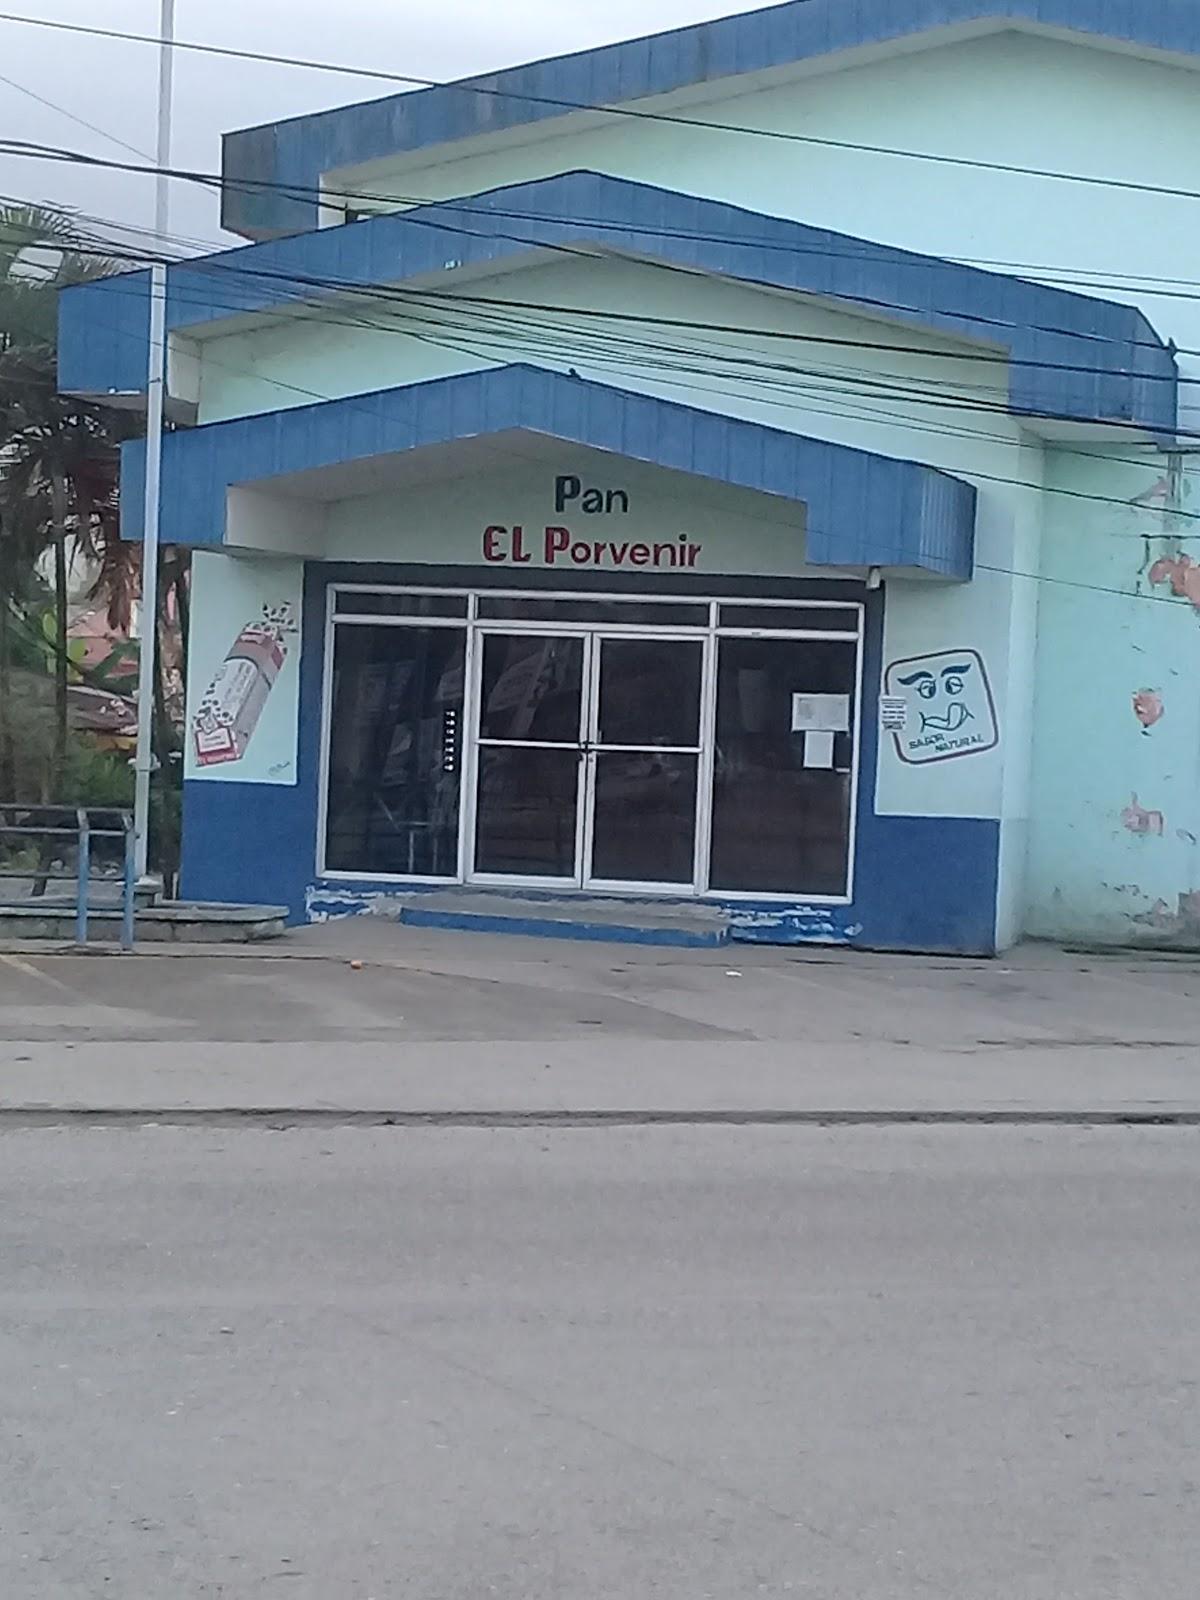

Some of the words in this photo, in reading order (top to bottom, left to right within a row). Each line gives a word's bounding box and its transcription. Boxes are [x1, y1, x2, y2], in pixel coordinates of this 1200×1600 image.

[555, 475, 629, 514] Pan
[544, 526, 702, 567] Porvenir
[908, 733, 945, 750] SABOR
[934, 733, 985, 753] NATURAL
